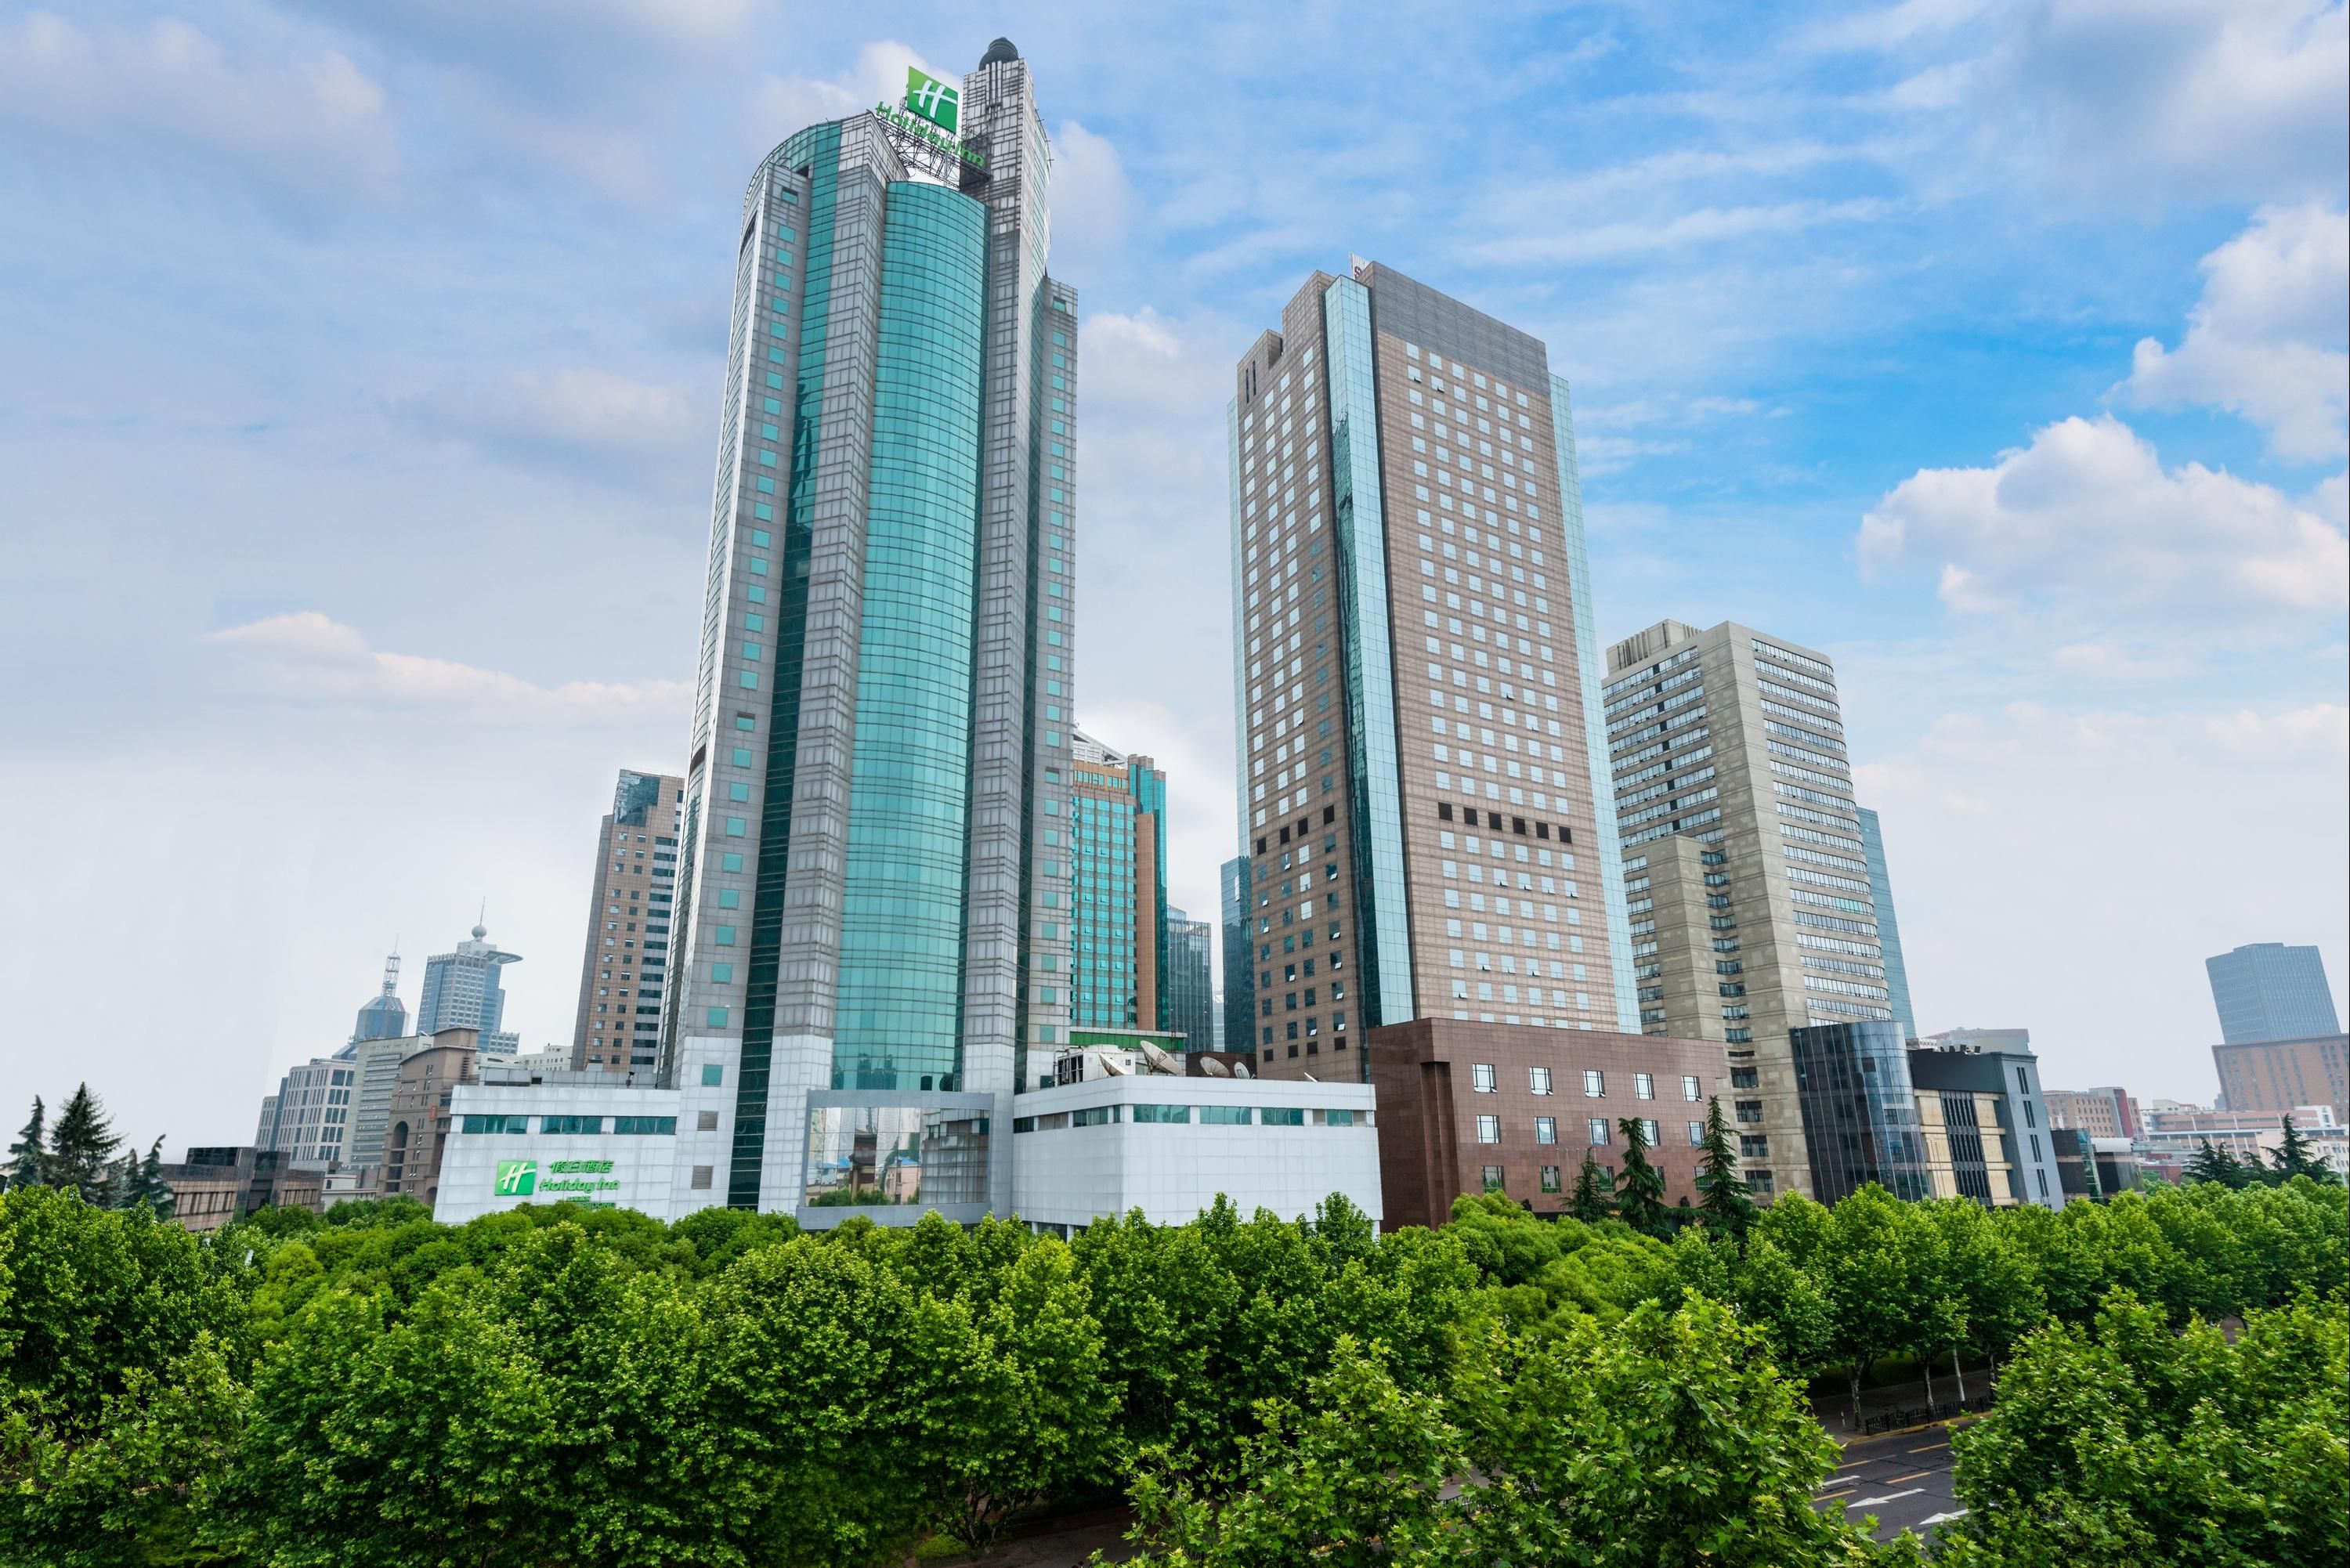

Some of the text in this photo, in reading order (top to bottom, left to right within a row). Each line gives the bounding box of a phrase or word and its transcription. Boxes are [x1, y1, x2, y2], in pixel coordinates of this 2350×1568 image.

[875, 101, 985, 168] Holiday Inn
[550, 1160, 613, 1173] 假日酒店
[539, 1177, 620, 1194] Holiday Inn
